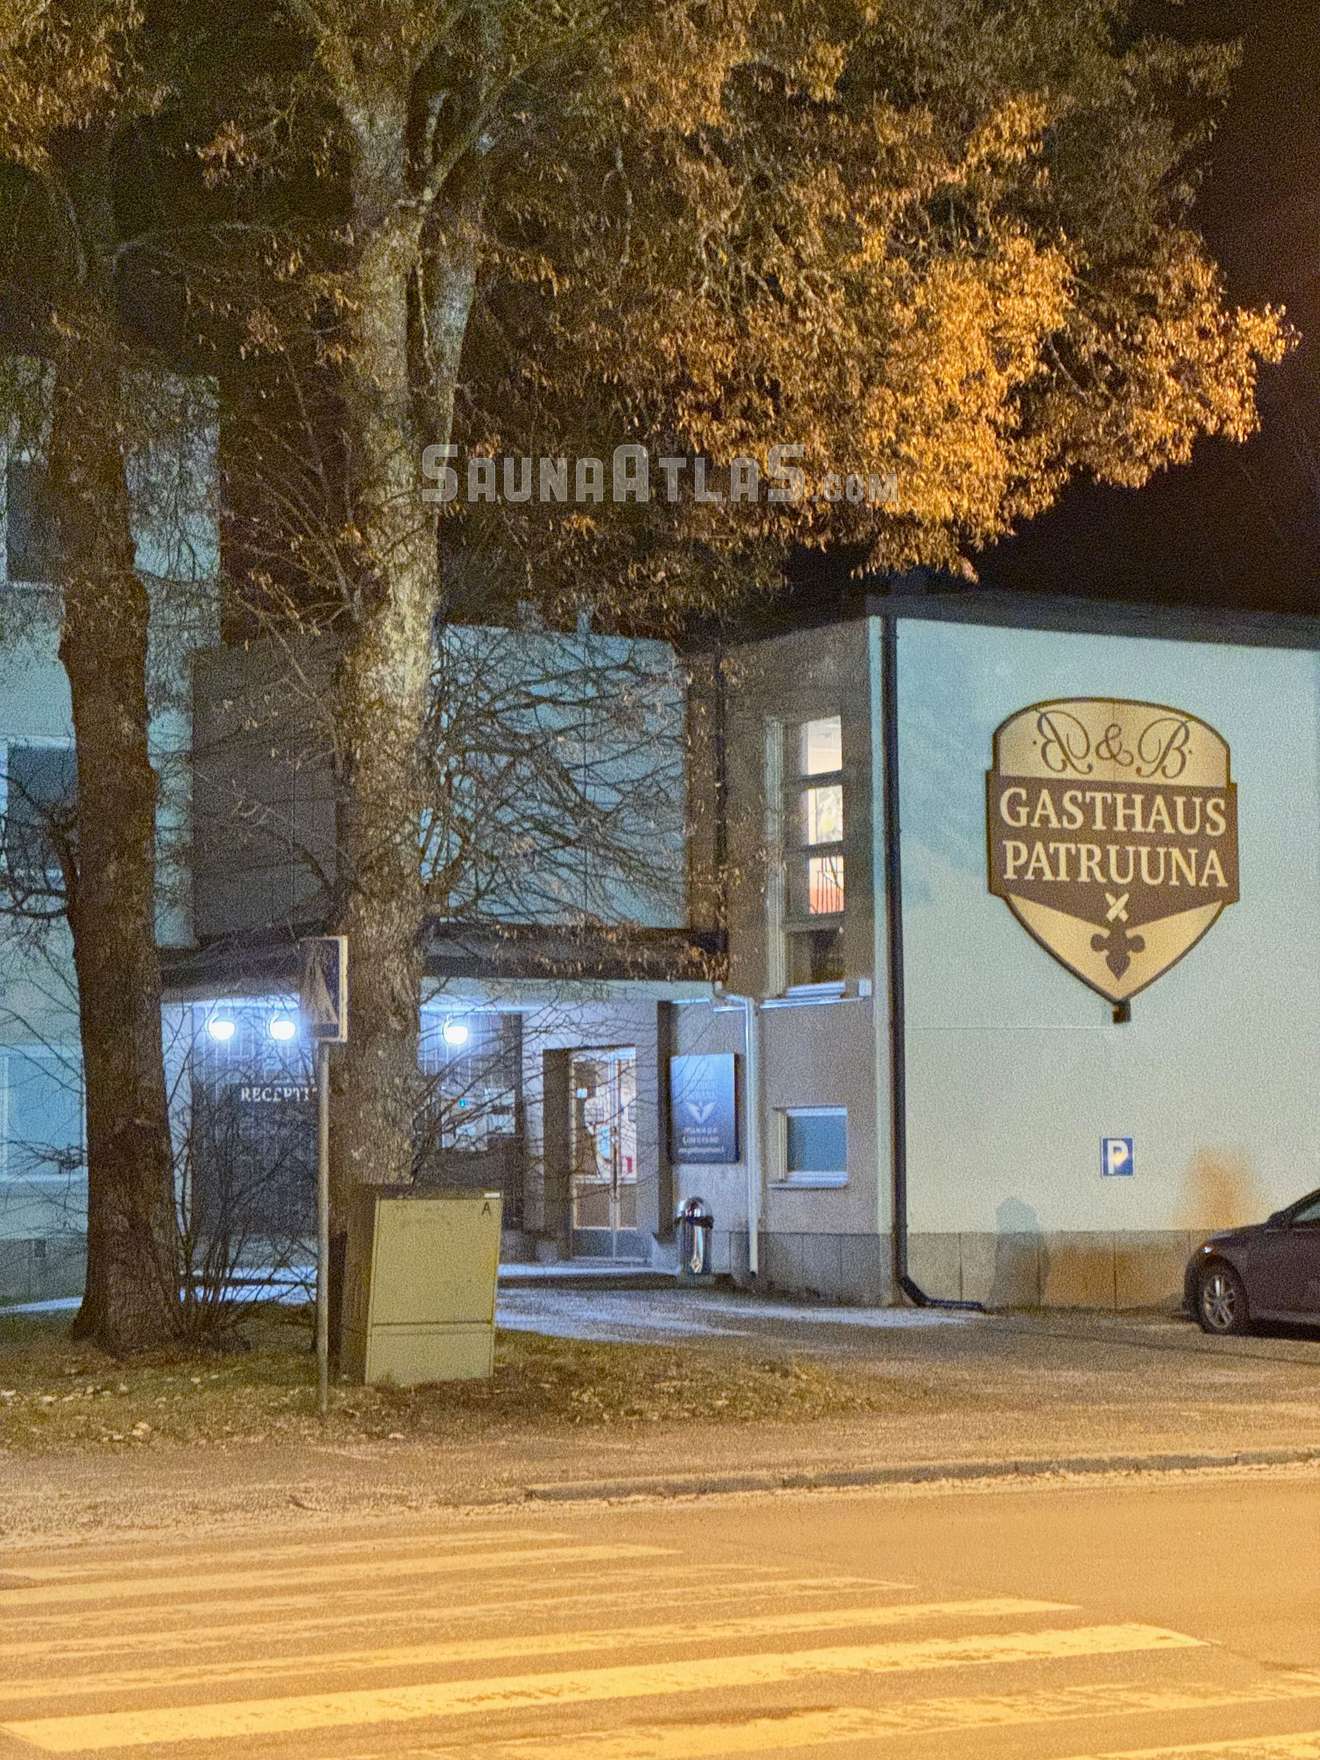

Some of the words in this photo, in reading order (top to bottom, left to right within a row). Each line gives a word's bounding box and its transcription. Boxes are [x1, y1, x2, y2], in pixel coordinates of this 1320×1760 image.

[1000, 786, 1227, 837] GASTHAUS
[1002, 840, 1229, 888] PATRUUNA
[241, 1086, 318, 1102] RECEPTI
[1107, 1140, 1129, 1175] P
[481, 1202, 492, 1216] A
